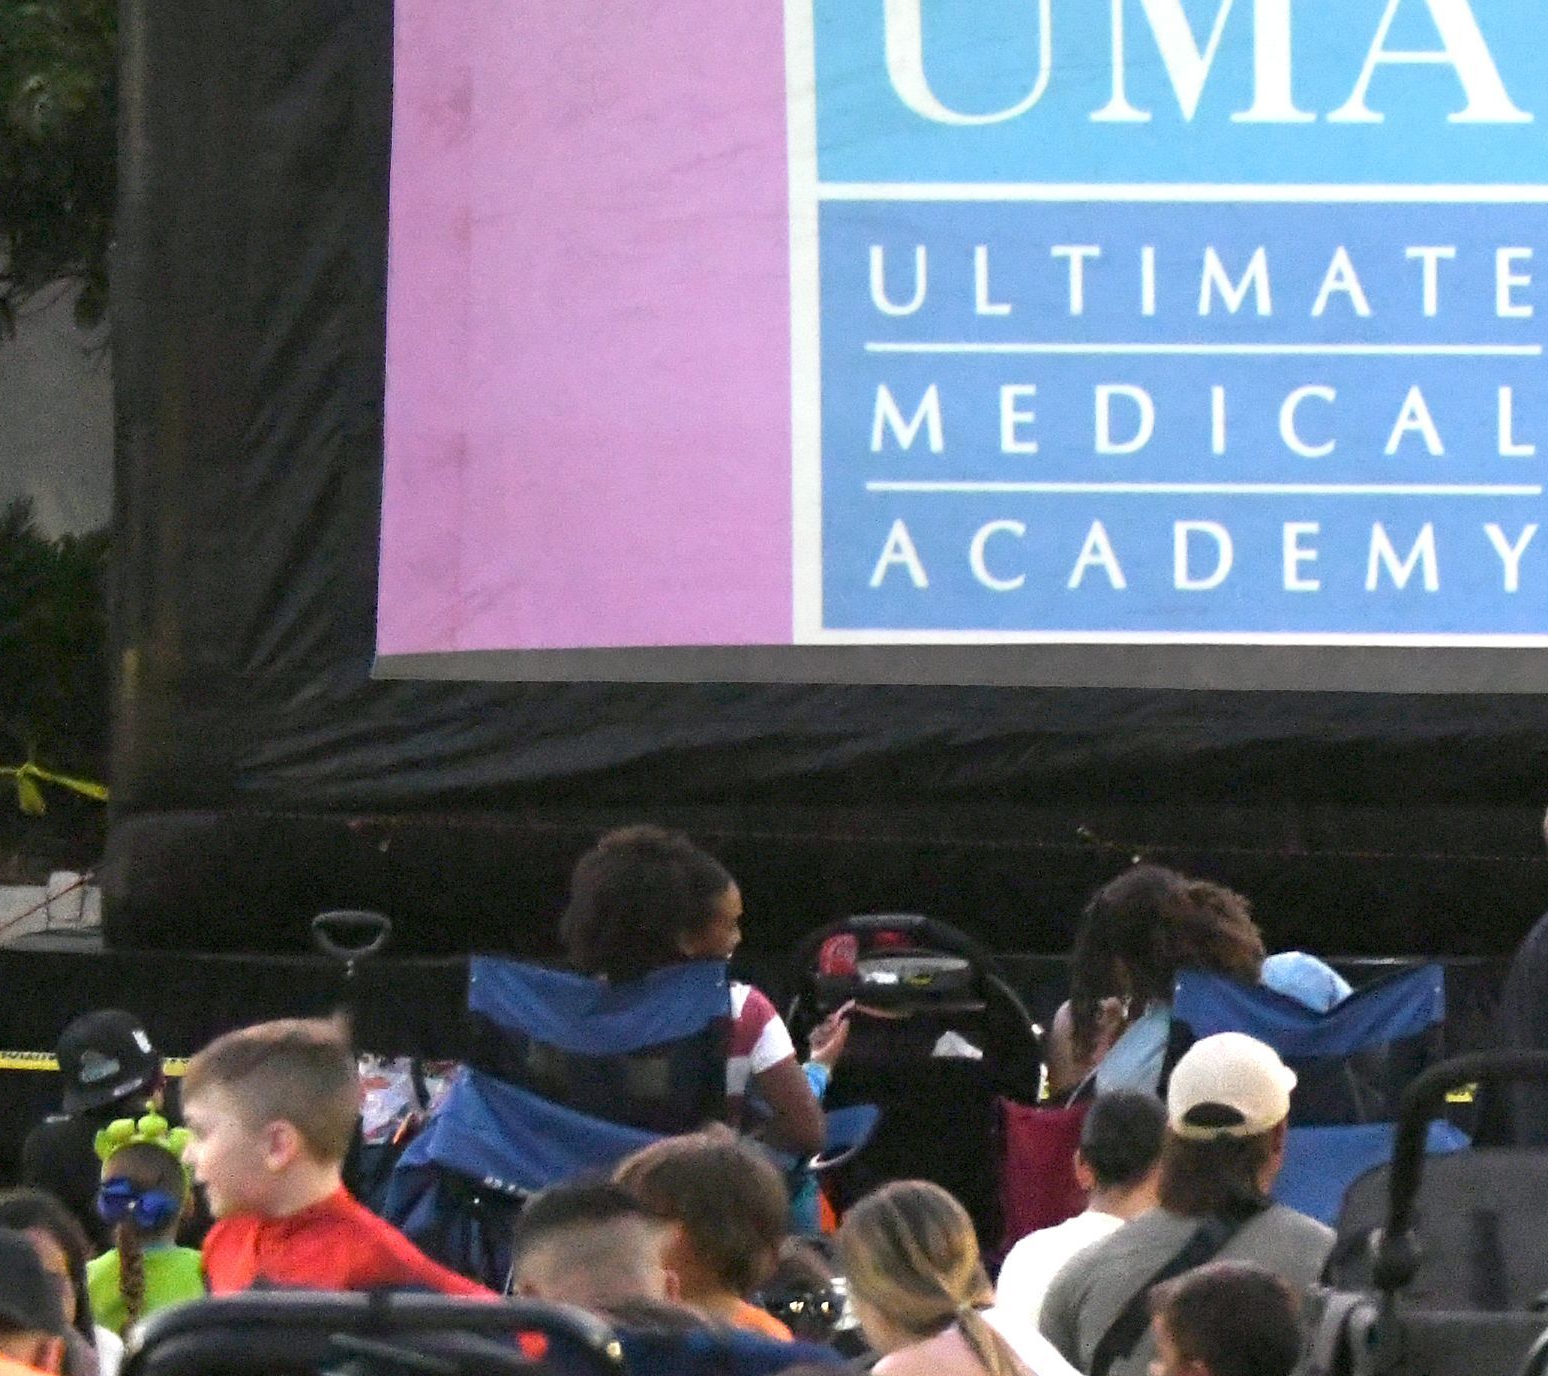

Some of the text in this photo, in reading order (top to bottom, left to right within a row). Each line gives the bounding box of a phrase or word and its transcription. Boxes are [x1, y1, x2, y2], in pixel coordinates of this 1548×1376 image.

[869, 244, 1533, 318] ULTIMATE
[870, 382, 1535, 457] MEDICAL
[870, 518, 1538, 592] ACADEMY
